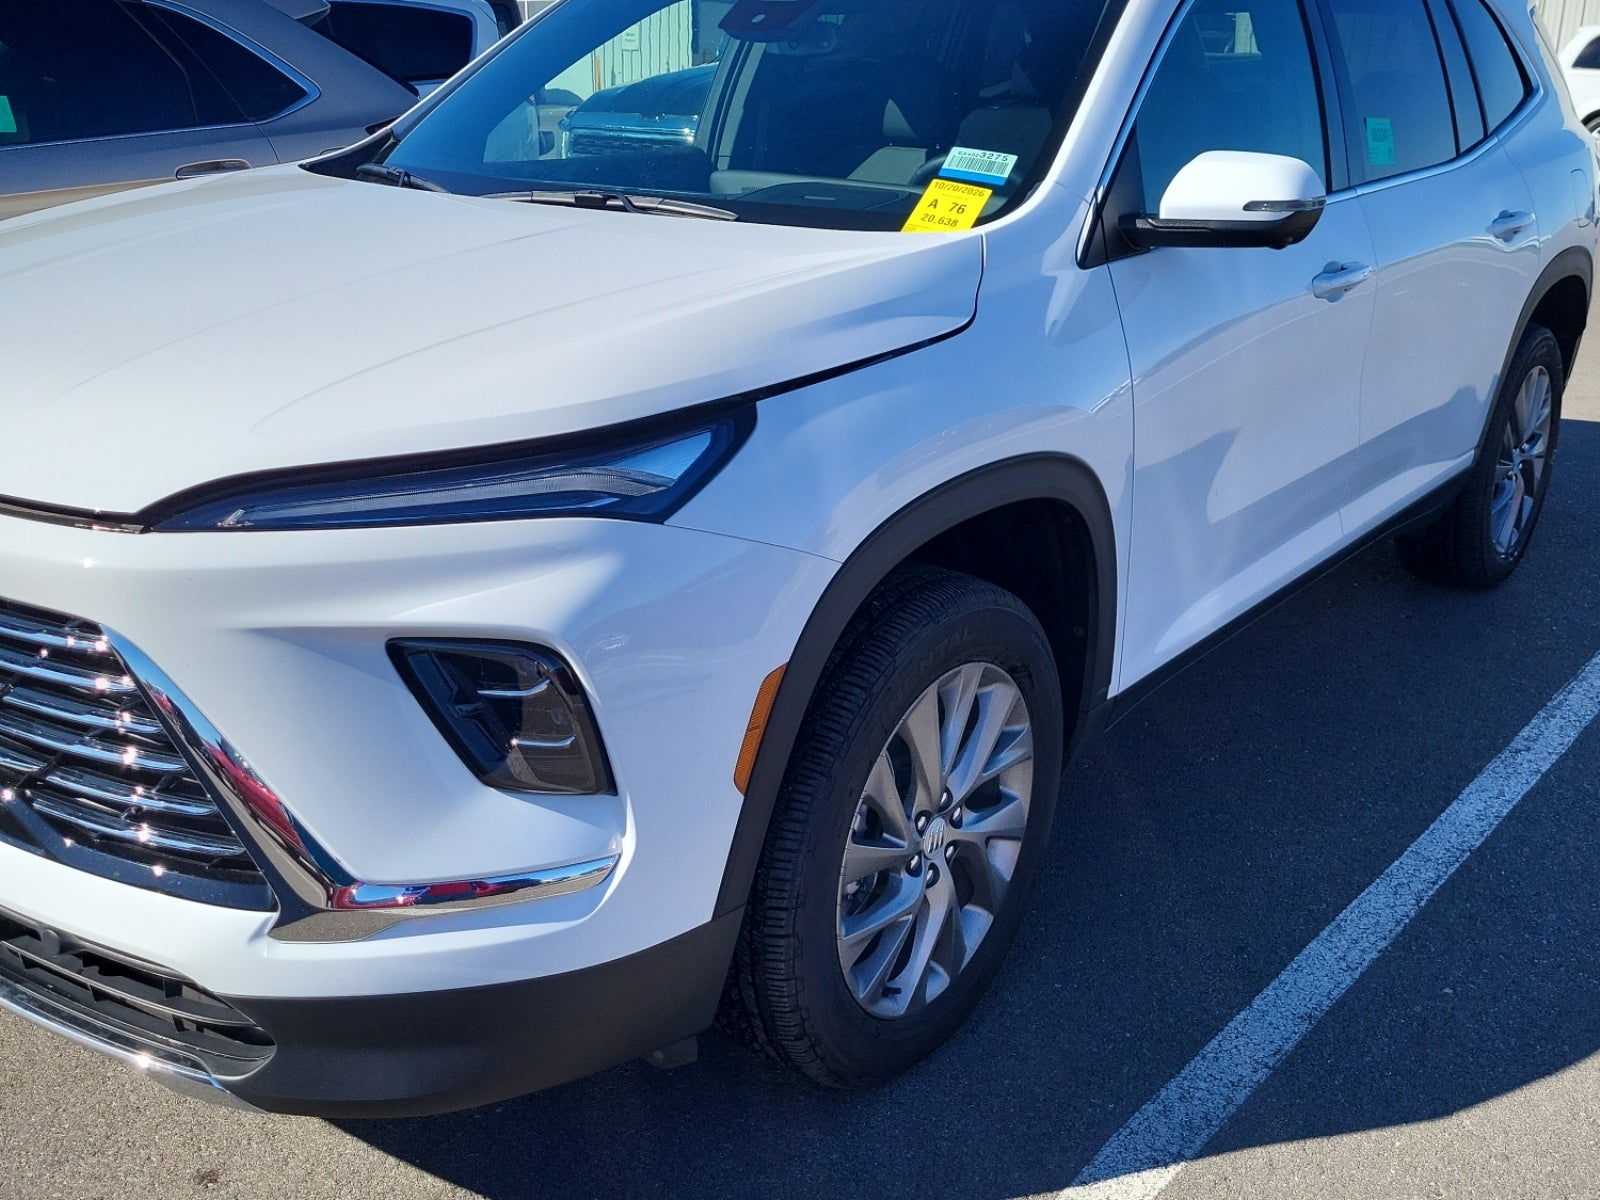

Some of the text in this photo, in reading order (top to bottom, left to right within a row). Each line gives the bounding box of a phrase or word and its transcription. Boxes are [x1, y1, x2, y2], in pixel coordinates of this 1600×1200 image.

[934, 181, 985, 197] 10/20/2026
[927, 199, 967, 215] A 76
